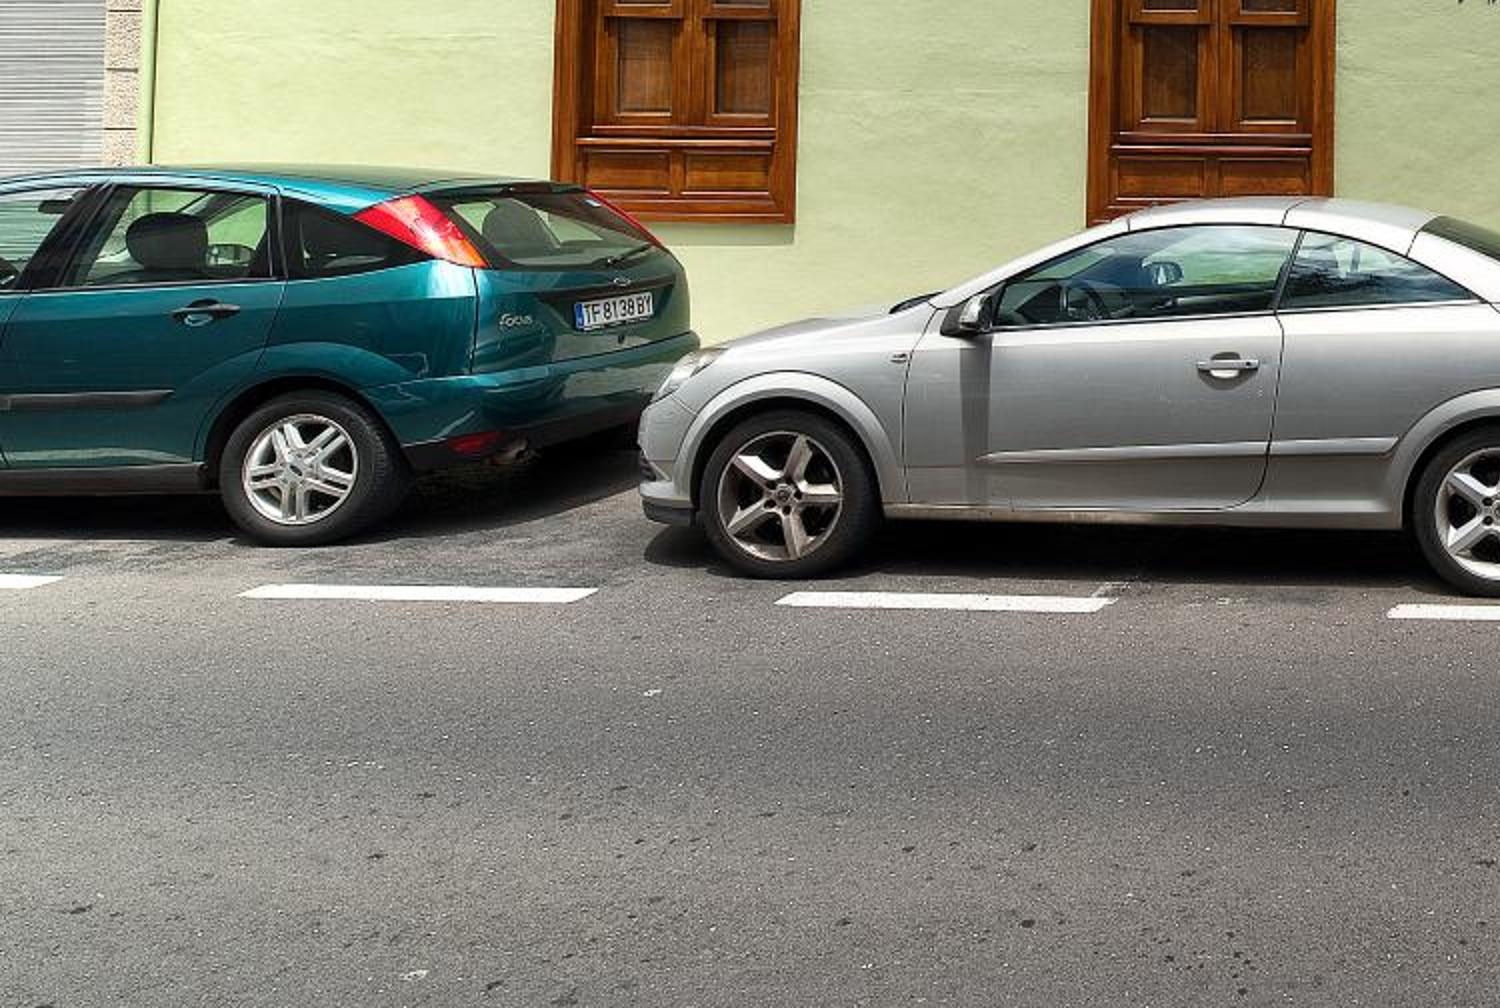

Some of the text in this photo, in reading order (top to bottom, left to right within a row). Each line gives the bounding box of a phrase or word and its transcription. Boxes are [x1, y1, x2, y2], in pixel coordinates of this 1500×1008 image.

[584, 294, 652, 324] TF 8138 BY
